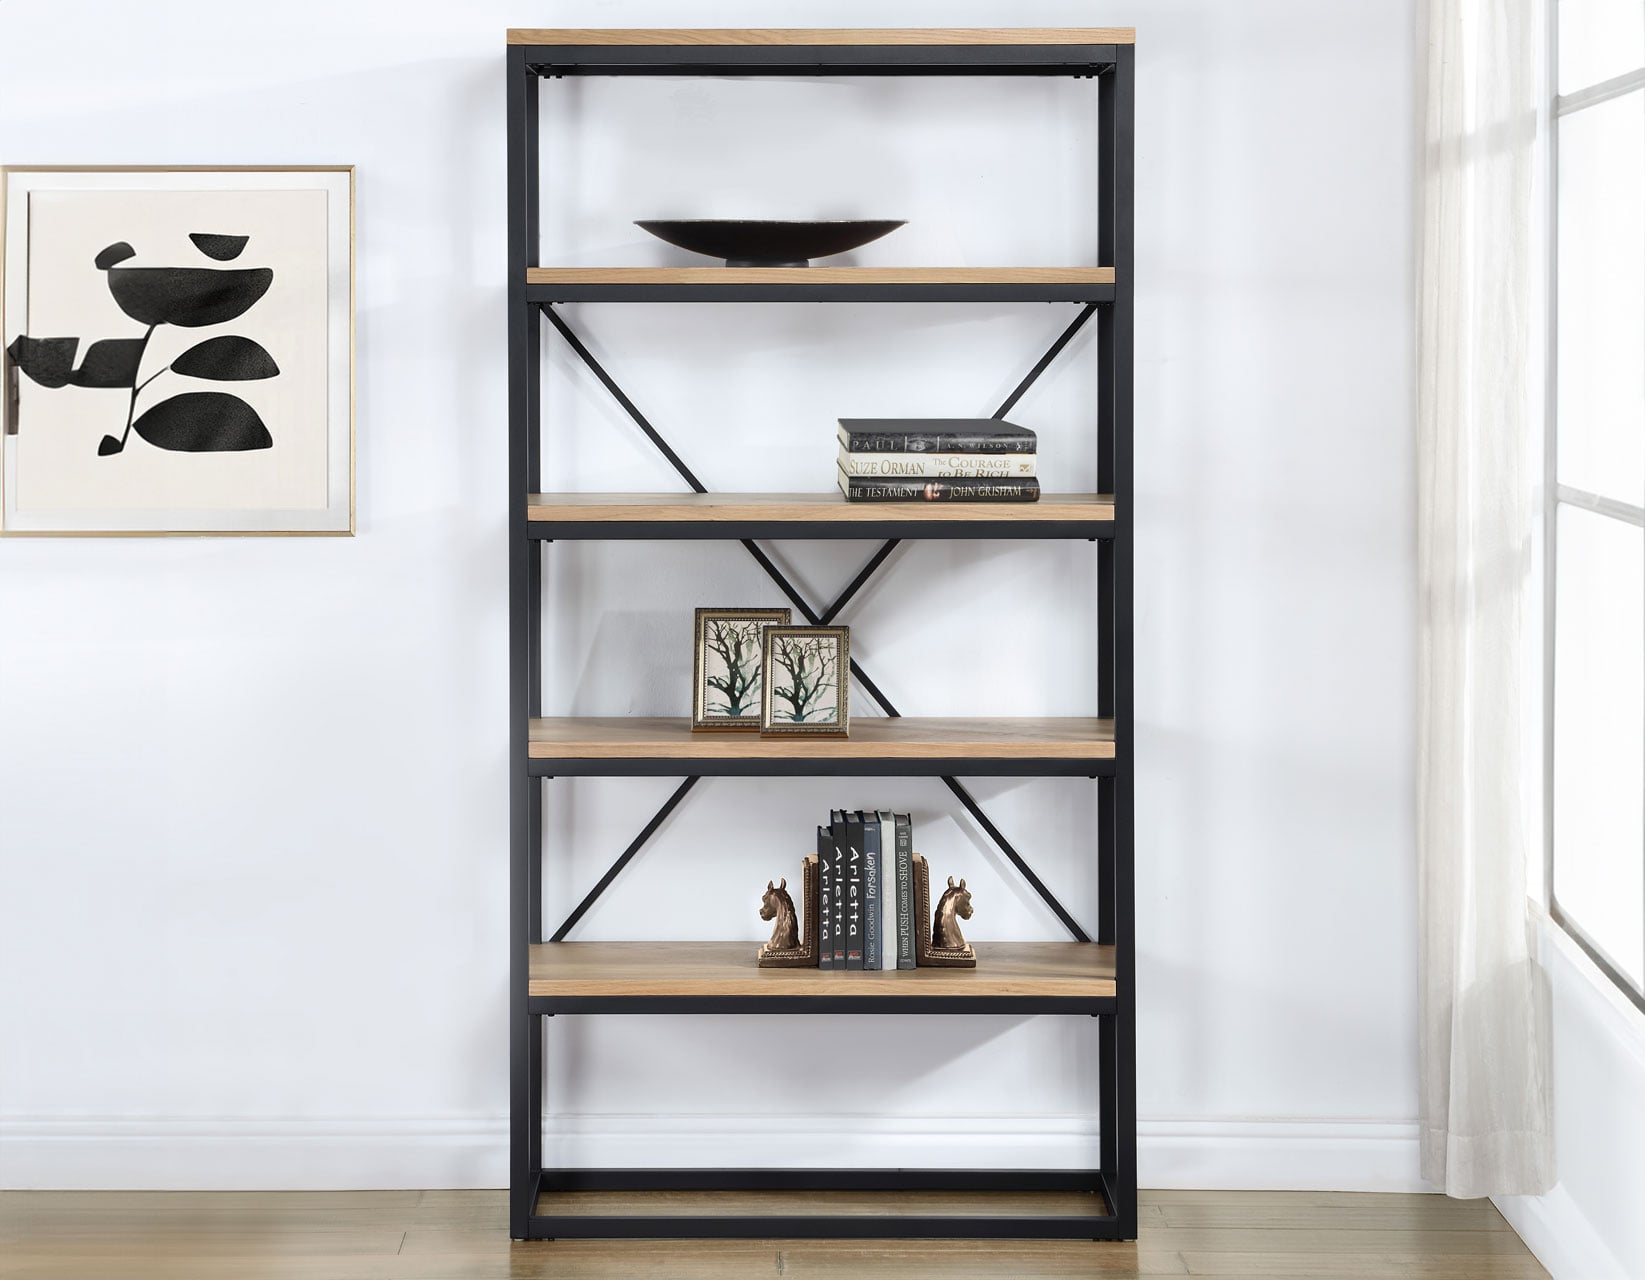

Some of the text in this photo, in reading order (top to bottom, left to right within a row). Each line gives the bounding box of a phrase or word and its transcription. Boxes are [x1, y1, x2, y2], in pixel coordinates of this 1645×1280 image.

[853, 441, 898, 450] PAUL
[850, 459, 925, 475] SUZE ORMAN
[933, 456, 1010, 468] The COURAGE
[849, 487, 918, 497] THE TESTAMENT
[949, 486, 1022, 500] JOHN GRISHAM
[864, 852, 877, 899] Forsaken
[899, 851, 908, 881] SHOVE
[835, 846, 843, 936] Arletta
[849, 846, 860, 936] Arletta
[901, 882, 907, 890] TO
[822, 859, 830, 940] Arletta
[866, 903, 875, 940] Goodwin
[900, 913, 909, 936] PUSH
[901, 937, 909, 957] WHEN
